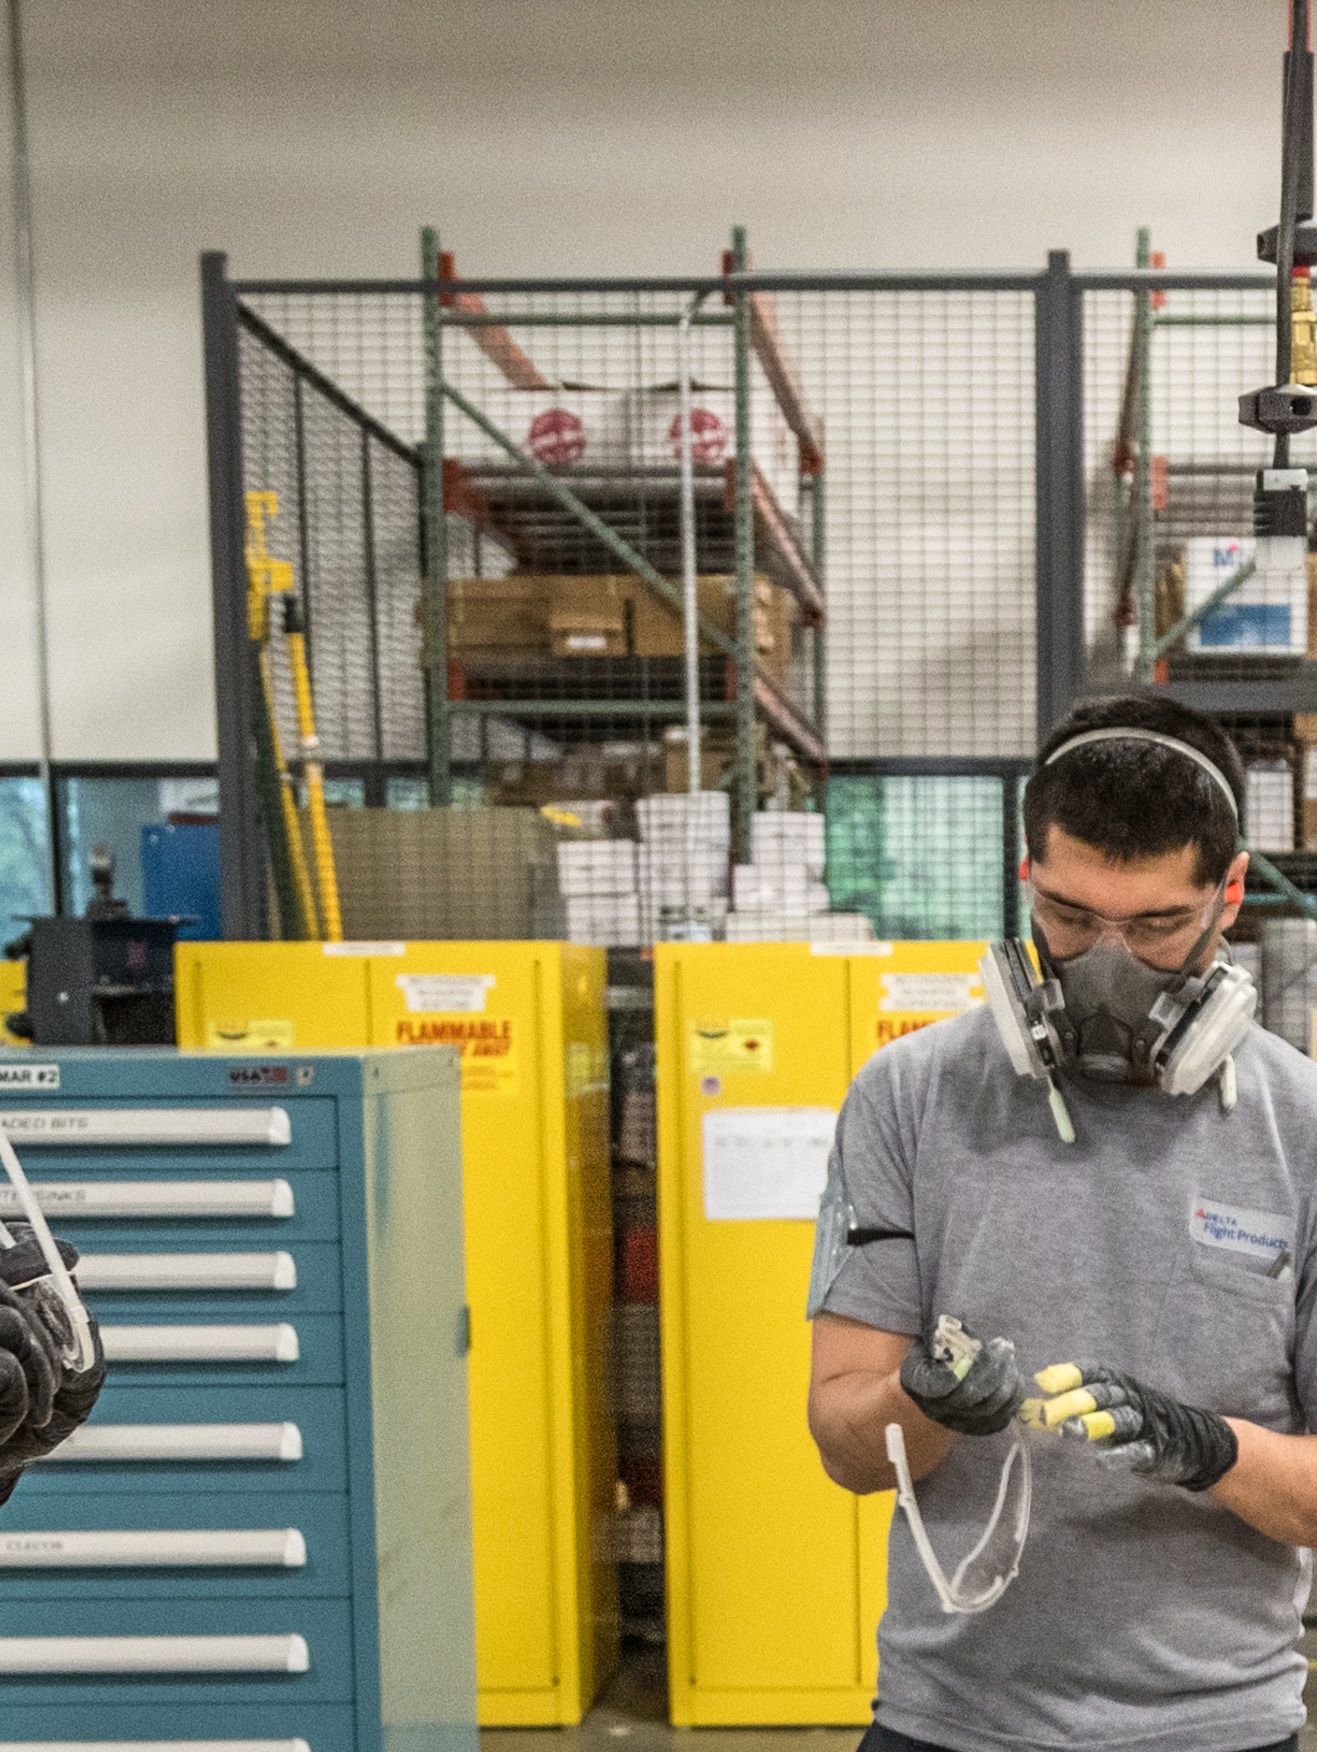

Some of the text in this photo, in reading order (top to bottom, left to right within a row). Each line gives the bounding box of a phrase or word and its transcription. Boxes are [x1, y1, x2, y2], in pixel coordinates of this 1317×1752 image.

[397, 1021, 510, 1041] FLAMMABLE
[1205, 1212, 1237, 1226] DELTA
[1203, 1220, 1289, 1252] Flight Products
